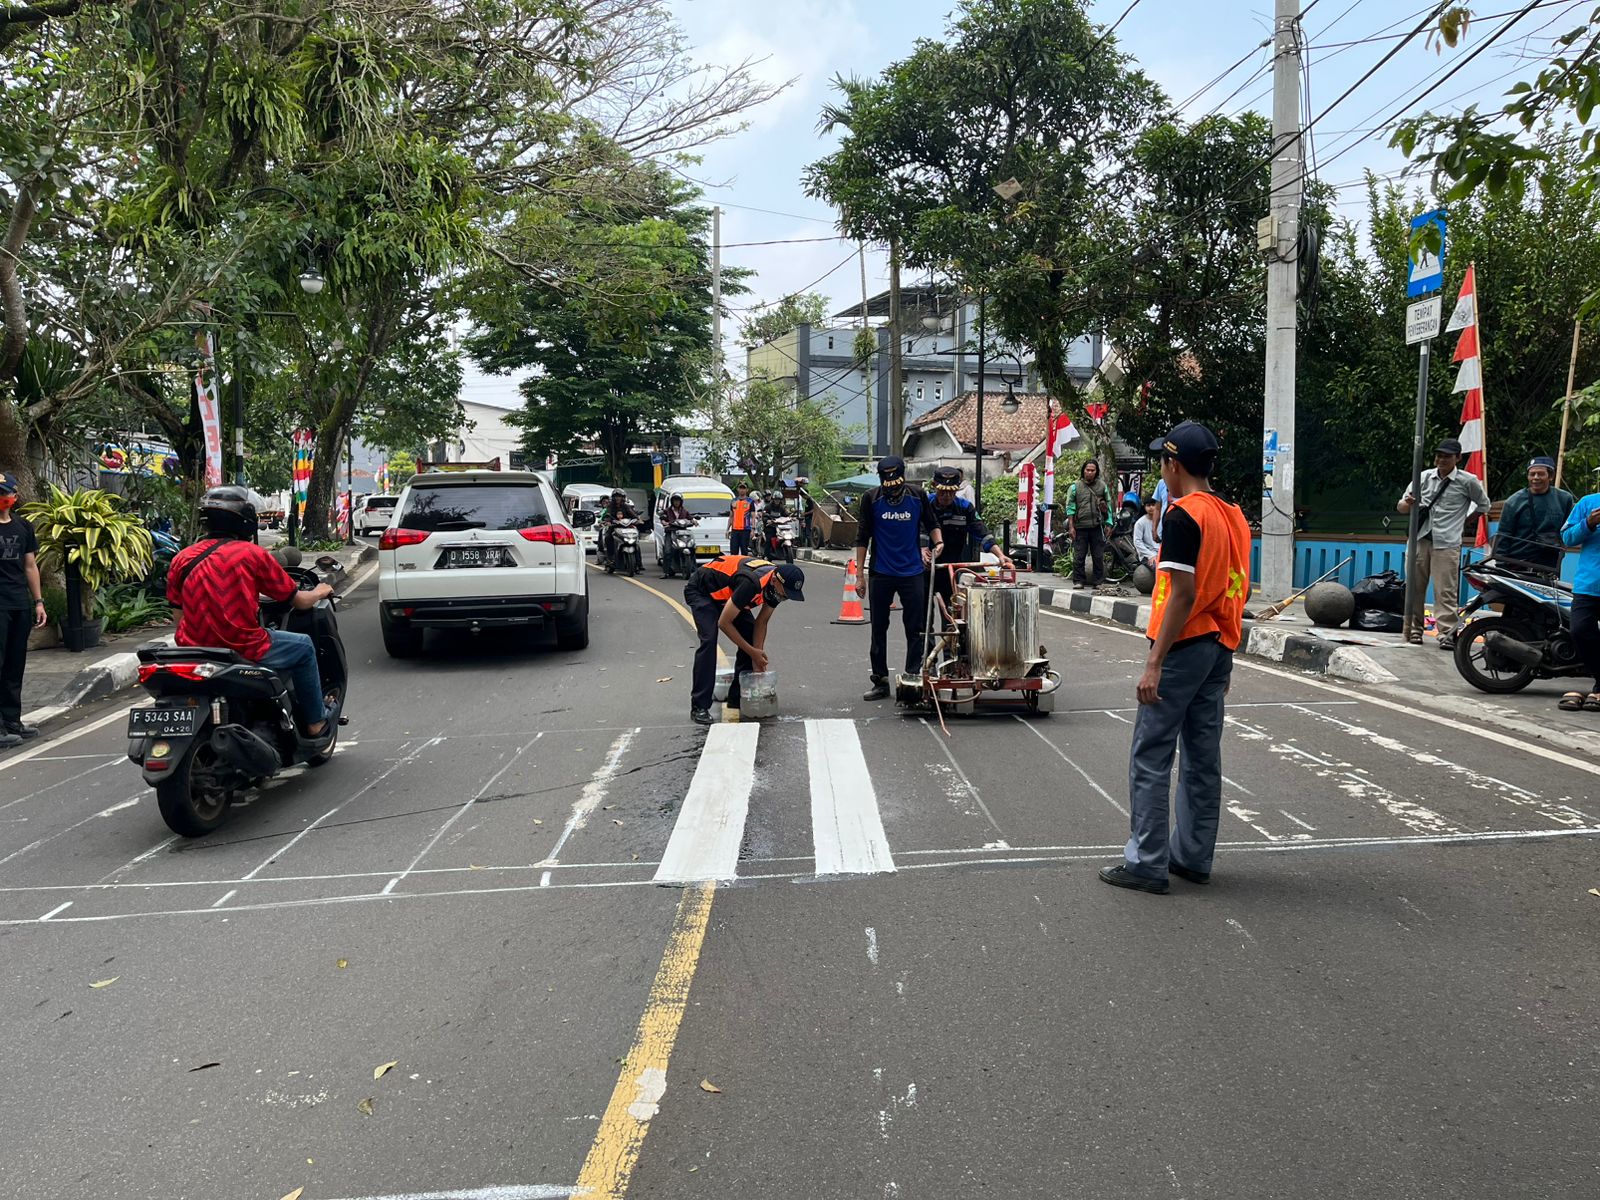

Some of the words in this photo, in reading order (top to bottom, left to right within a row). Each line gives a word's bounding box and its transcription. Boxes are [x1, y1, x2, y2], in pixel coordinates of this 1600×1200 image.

[1414, 304, 1433, 321] TEMPAT
[881, 511, 912, 520] dishub
[462, 550, 480, 560] 1558
[133, 712, 141, 723] F
[144, 711, 170, 723] 5343
[173, 710, 192, 722] SAA
